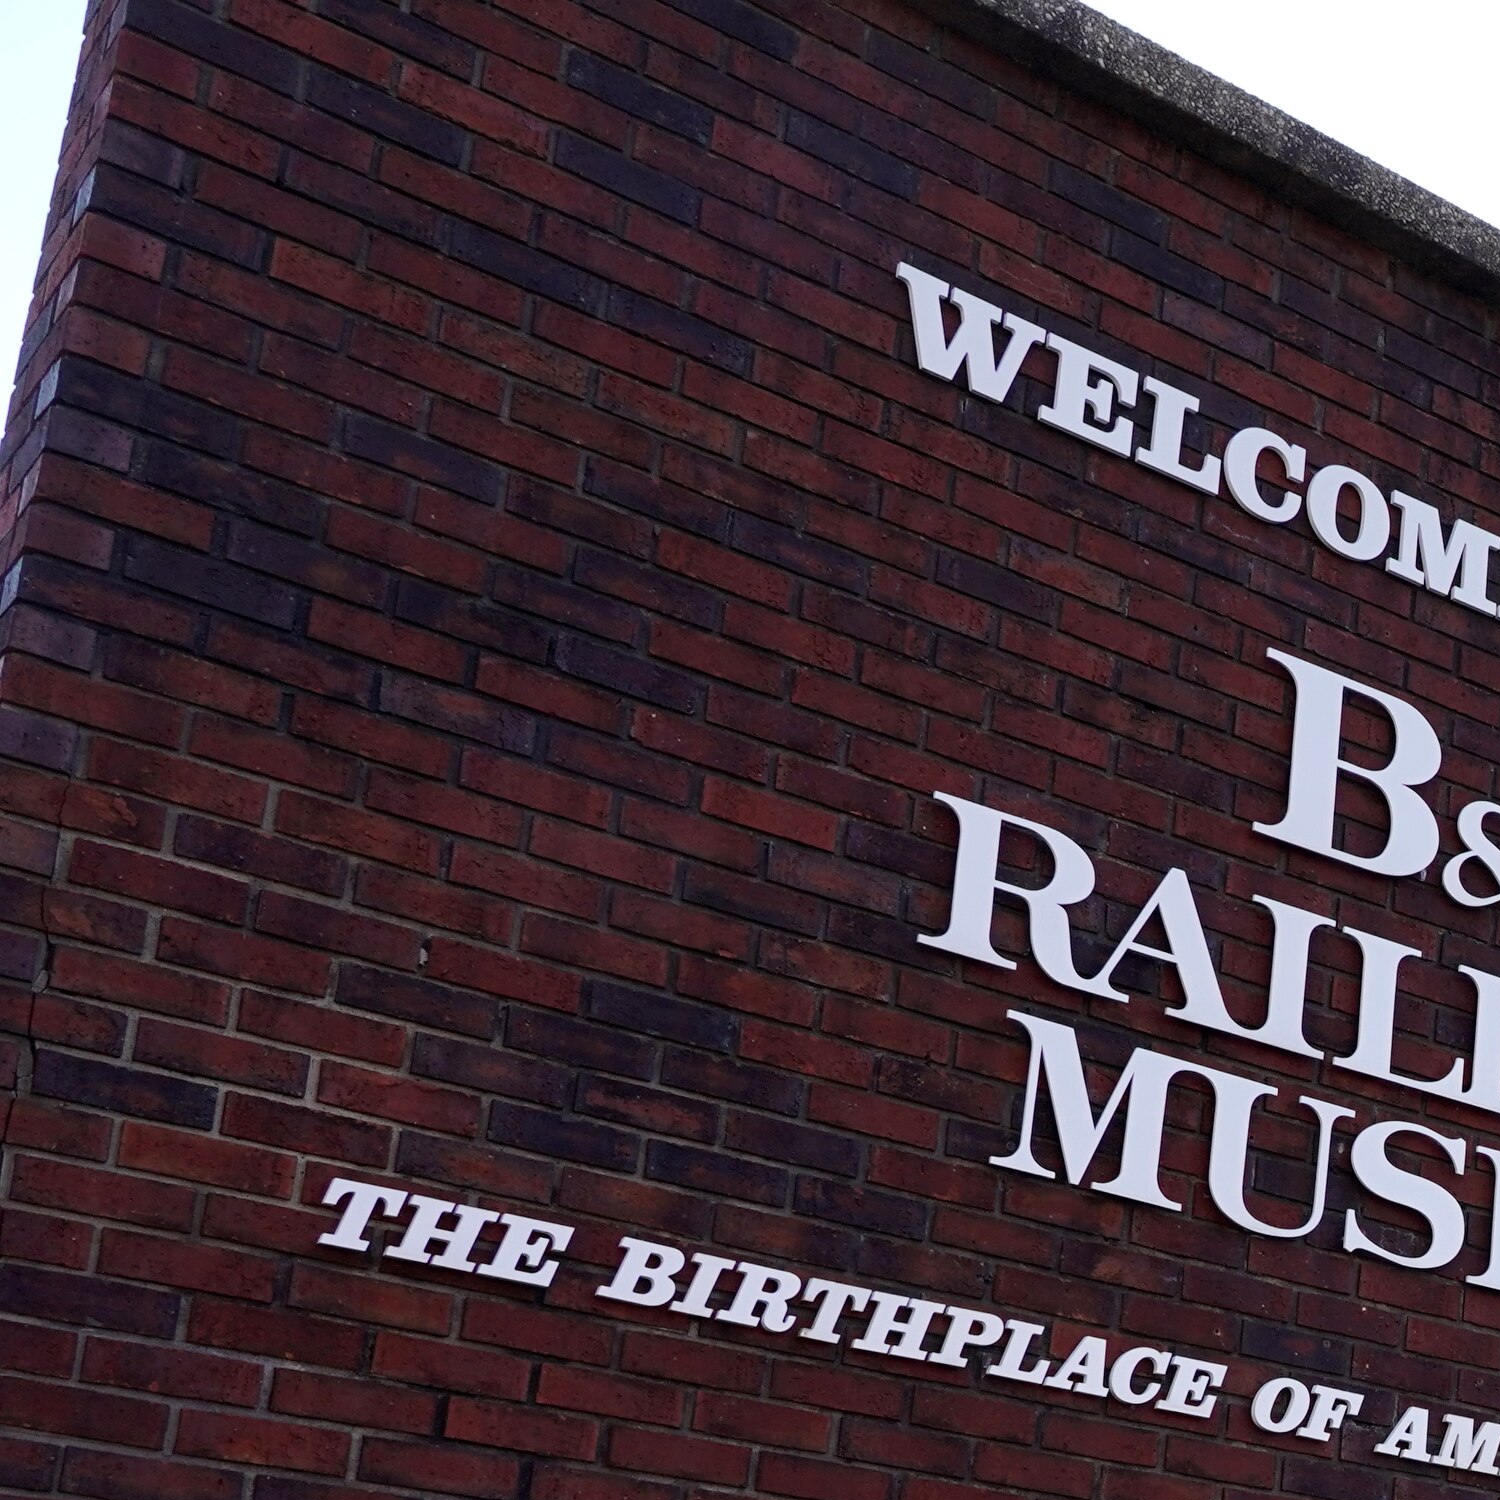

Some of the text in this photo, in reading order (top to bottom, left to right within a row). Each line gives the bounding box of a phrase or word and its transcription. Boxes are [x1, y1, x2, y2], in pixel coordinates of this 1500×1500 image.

[317, 1177, 576, 1289] THE
[594, 1236, 1229, 1420] BIRTHPLACE
[1250, 1377, 1365, 1443] OF
